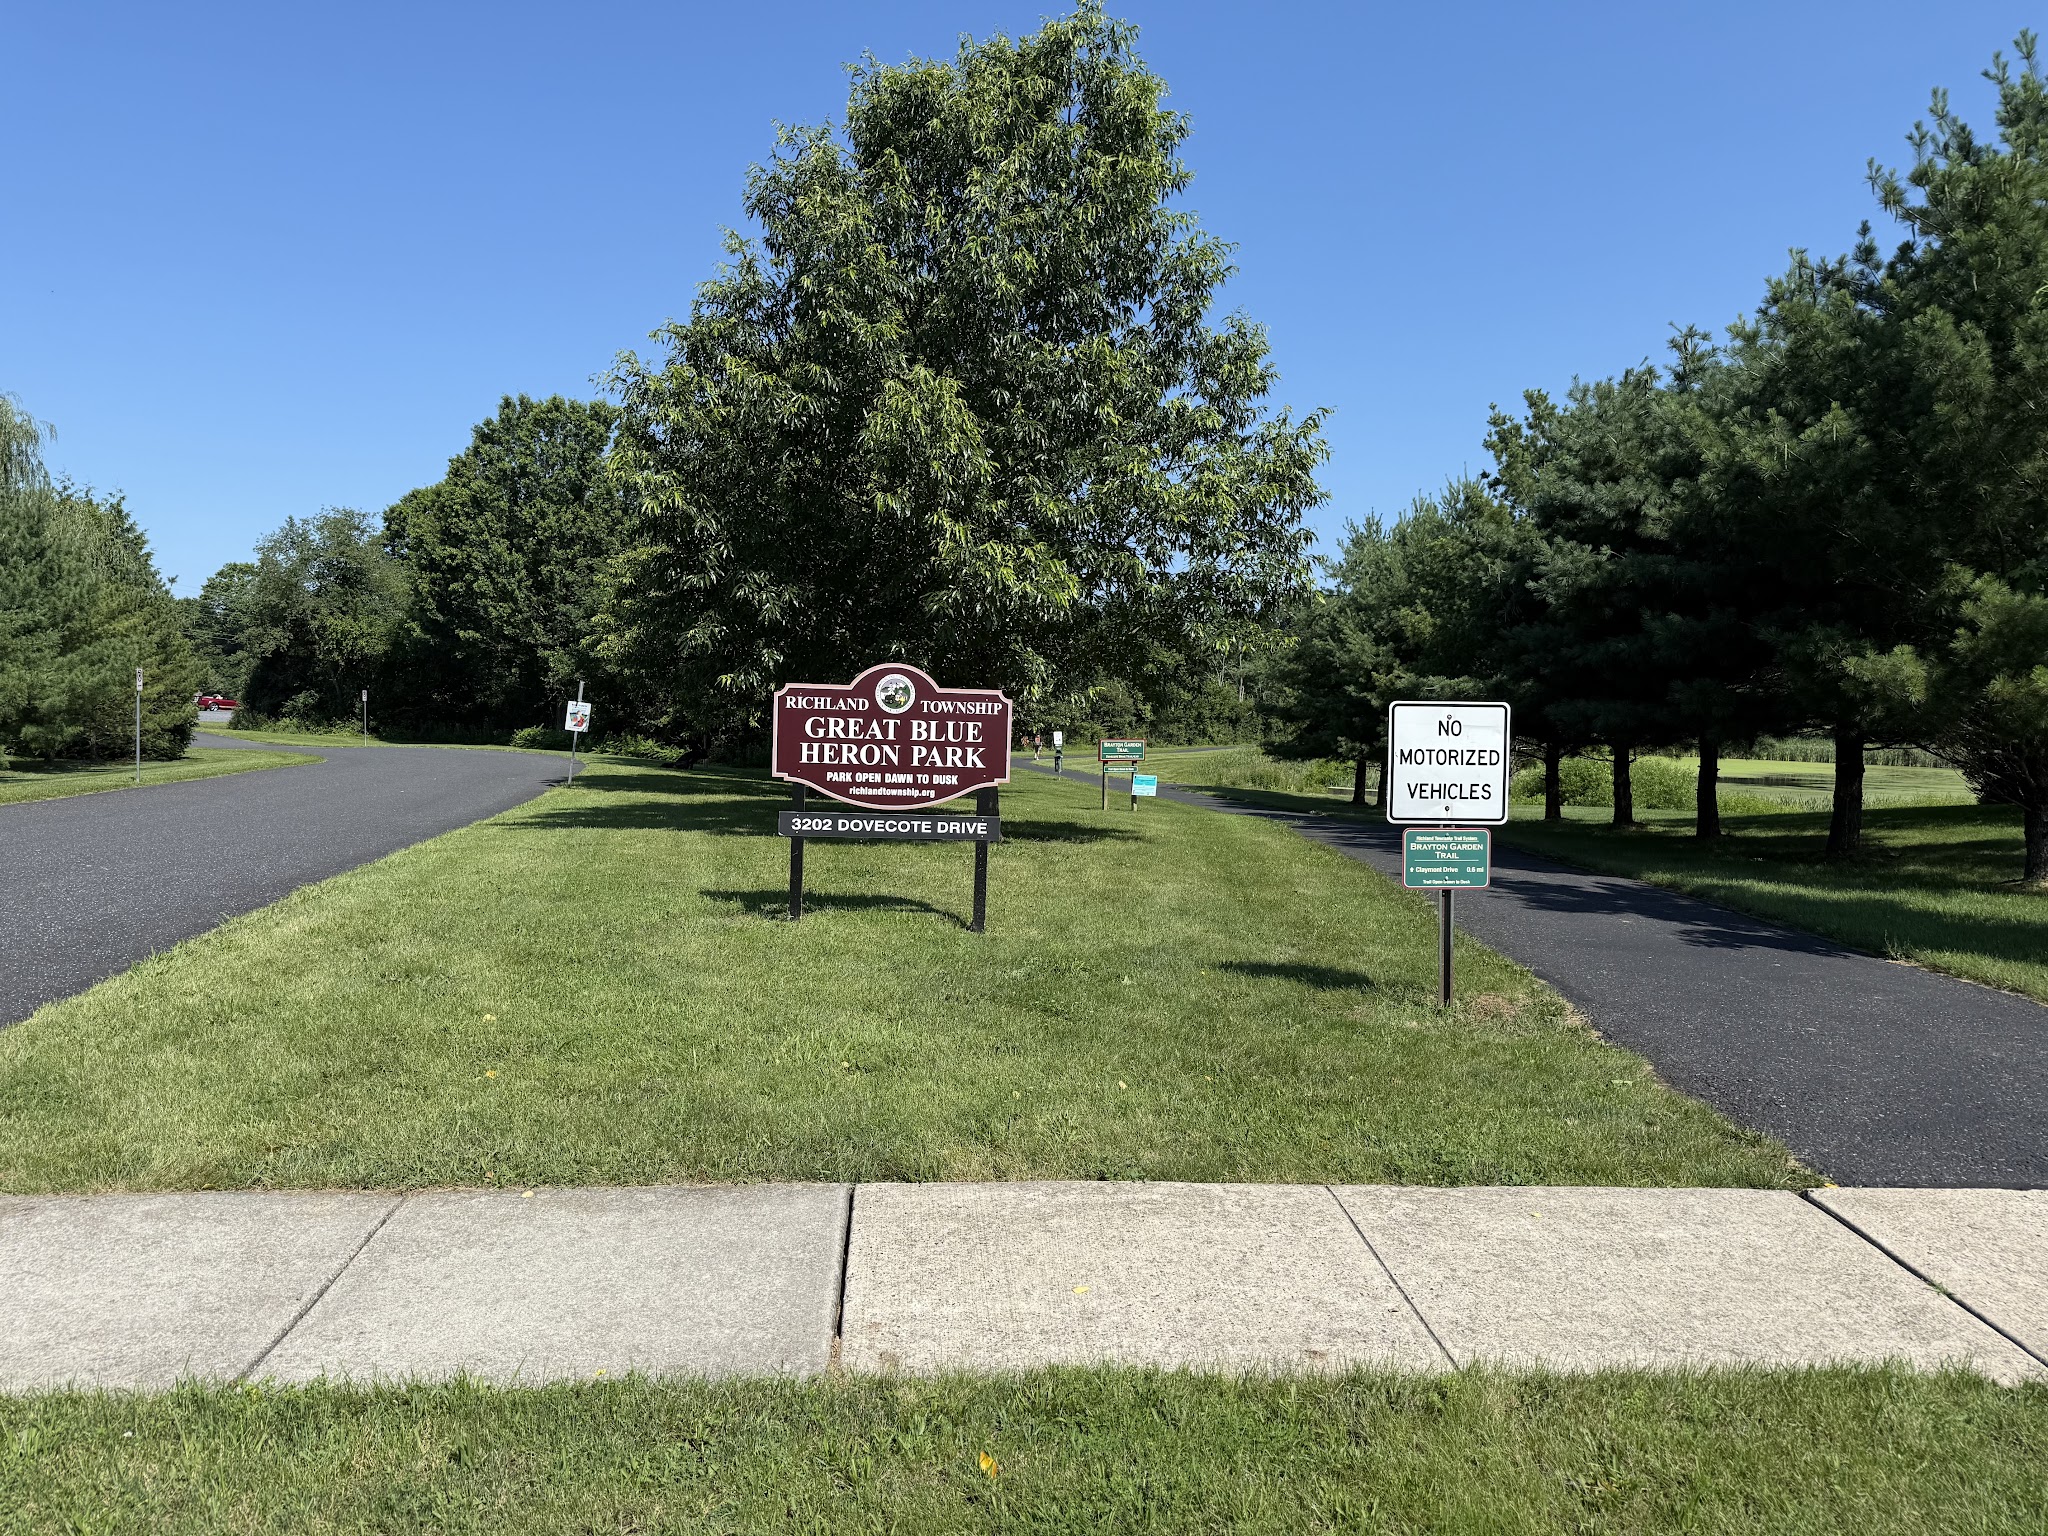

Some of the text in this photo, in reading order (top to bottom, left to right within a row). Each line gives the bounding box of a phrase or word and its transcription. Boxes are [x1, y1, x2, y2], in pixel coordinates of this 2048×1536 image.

[785, 695, 1003, 716] RICHLAND TOWNSHIP
[804, 716, 983, 743] GREAT BLUE
[1438, 720, 1462, 736] NO
[798, 742, 986, 769] HERON PARK
[1399, 749, 1500, 766] MOTORIZED
[826, 771, 959, 785] PARK OPEN DAWN TO DUSK
[849, 786, 936, 799] richlandtownship.org
[1407, 783, 1492, 800] VEHICLES
[791, 818, 988, 835] 3202 DOVECOTE DRIVE
[1435, 851, 1460, 859] TRAIL
